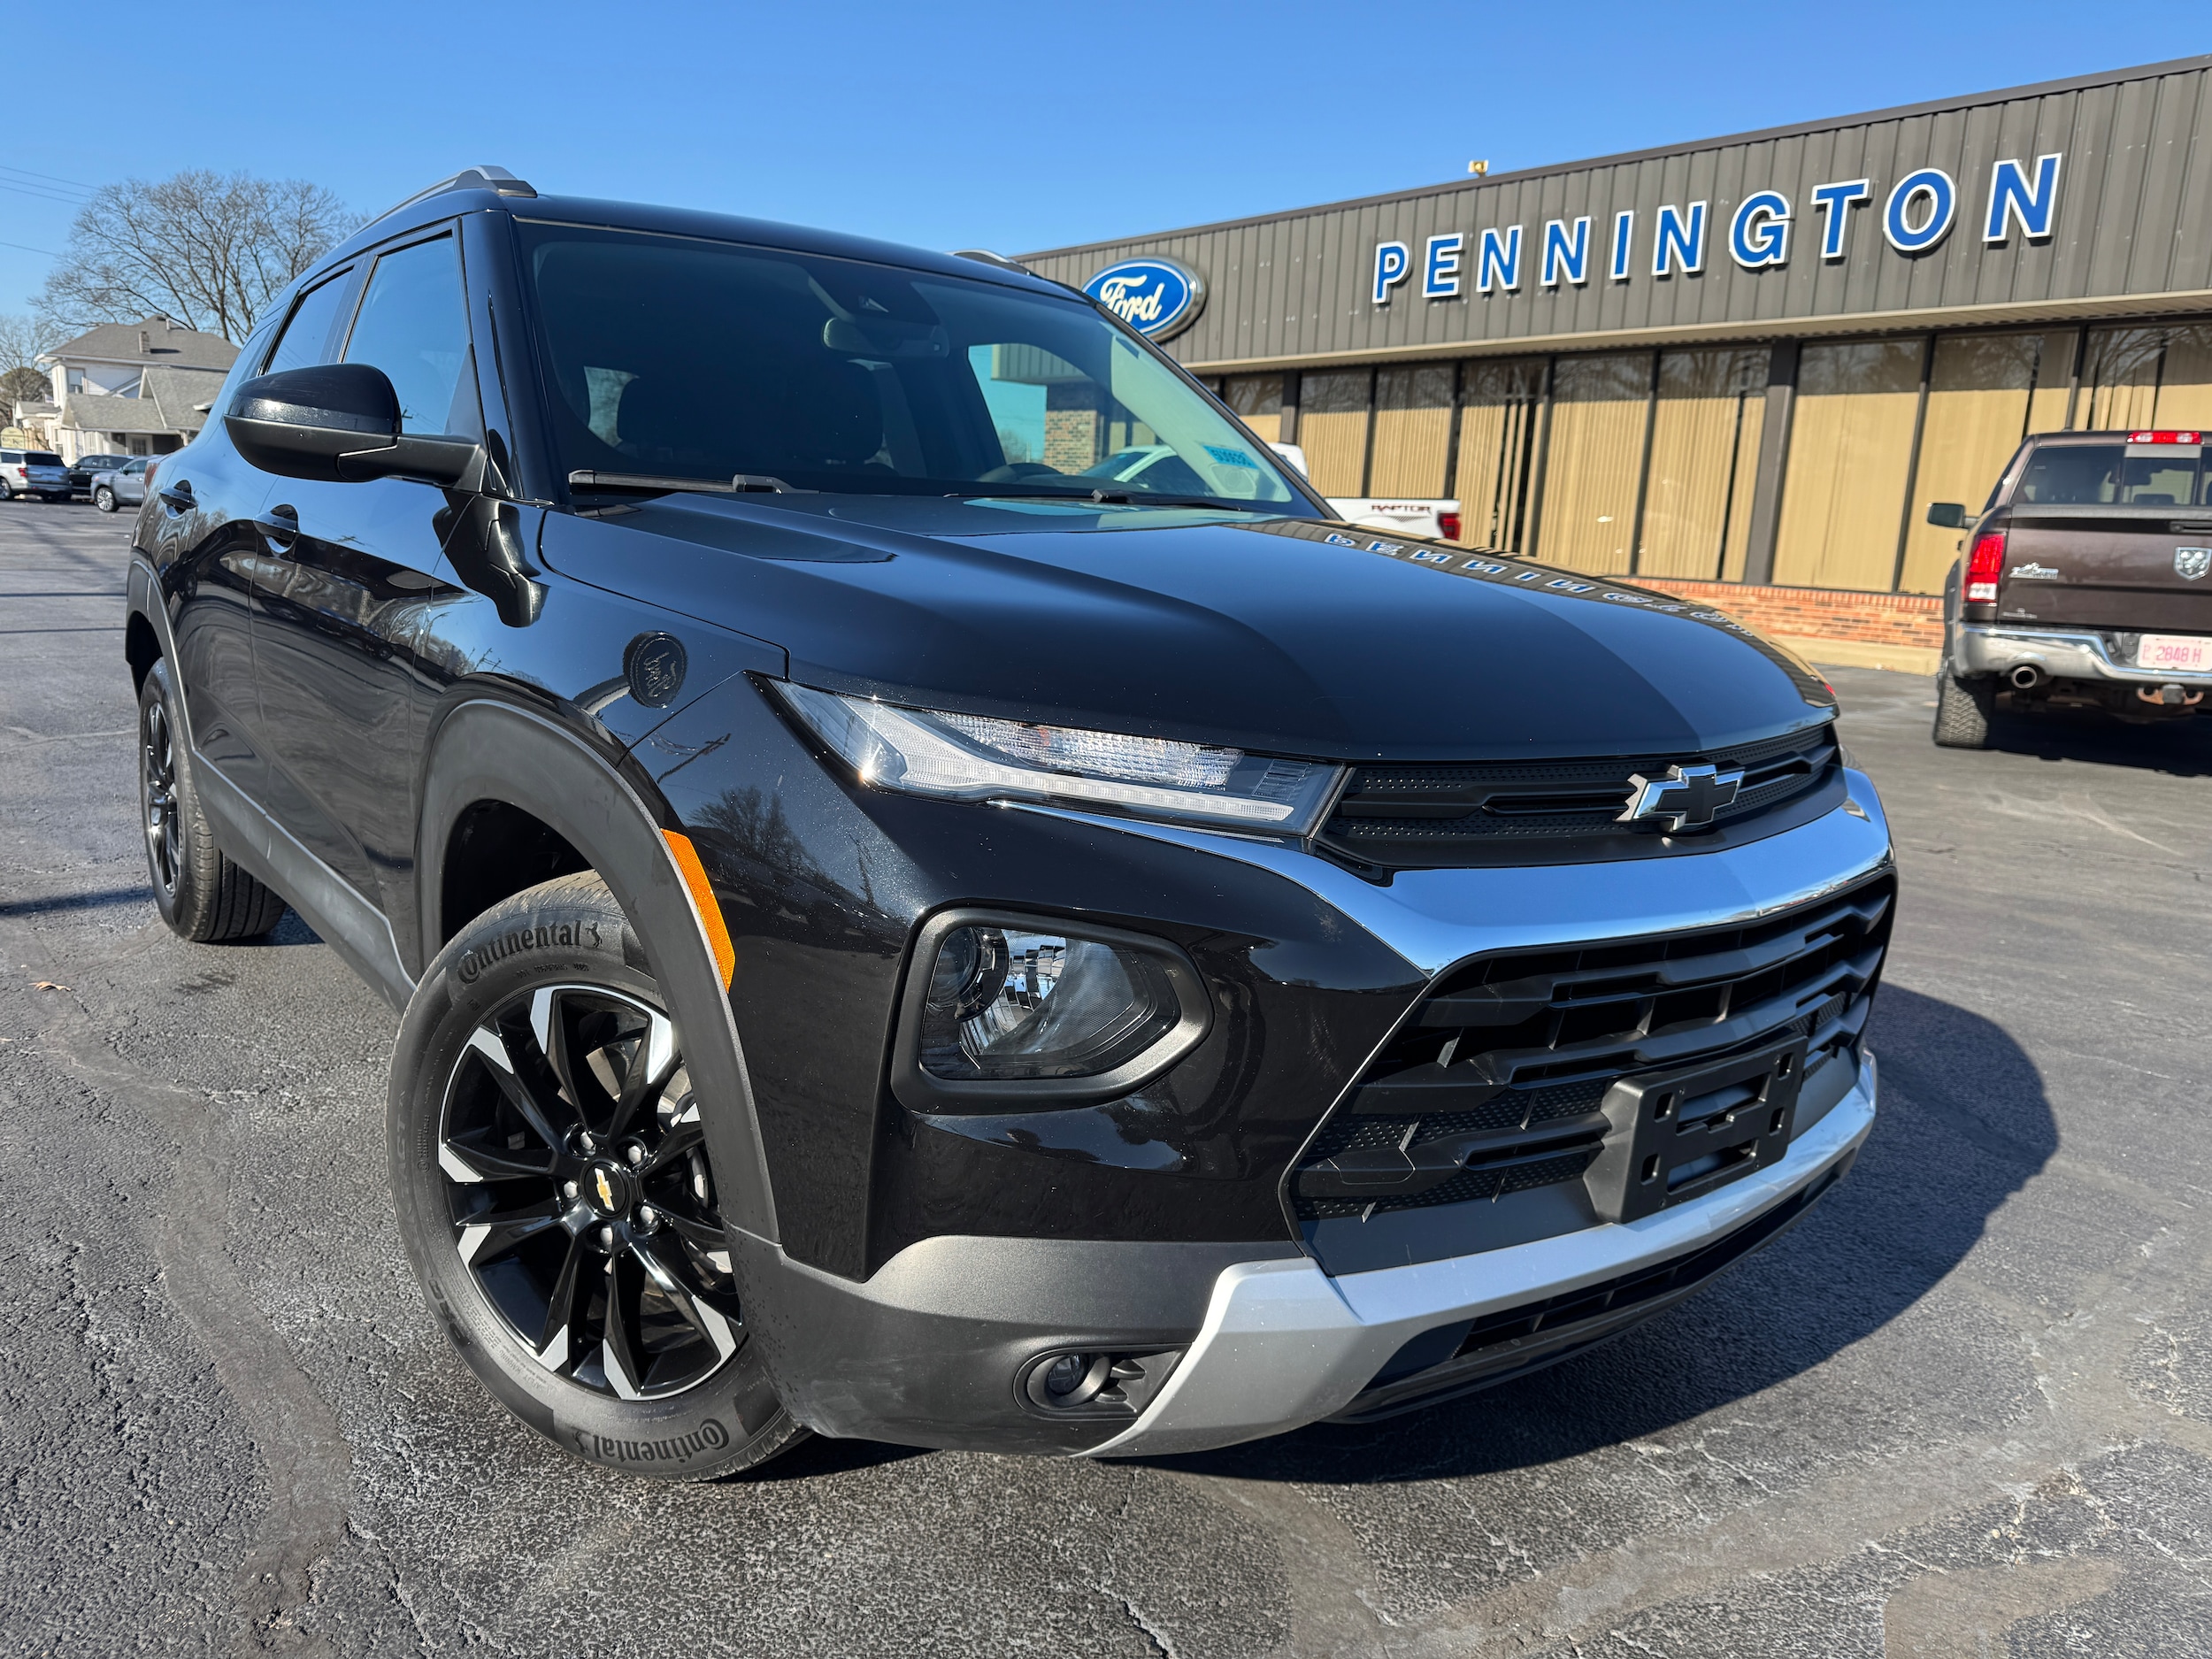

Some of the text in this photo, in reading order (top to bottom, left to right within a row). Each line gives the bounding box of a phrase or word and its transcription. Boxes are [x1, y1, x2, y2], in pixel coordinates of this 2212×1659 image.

[1371, 152, 2063, 304] PENNINGTON
[1100, 274, 1165, 323] Ford
[457, 920, 582, 985] Continental
[593, 1418, 730, 1463] Continental
